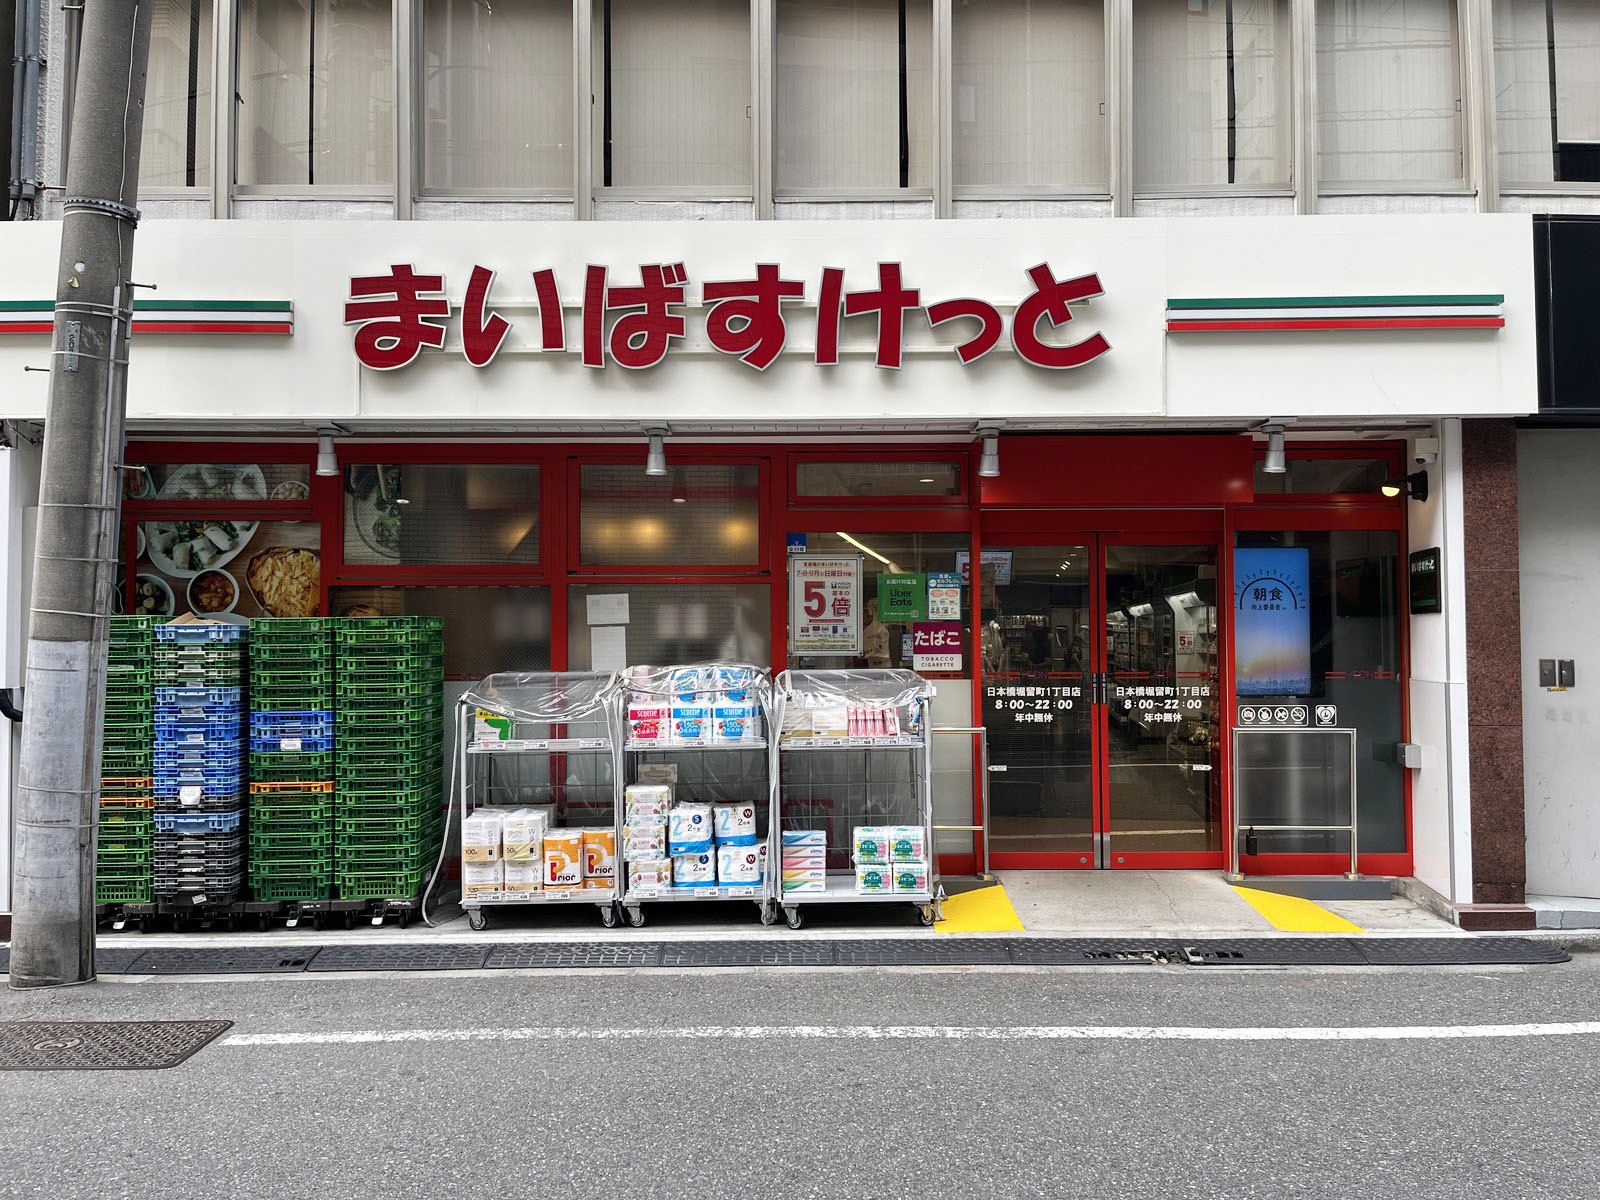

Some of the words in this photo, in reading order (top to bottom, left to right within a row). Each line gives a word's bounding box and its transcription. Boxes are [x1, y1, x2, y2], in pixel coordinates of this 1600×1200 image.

[344, 261, 1111, 372] まいばすけっと
[890, 589, 912, 597] Uber
[1253, 587, 1283, 601] 朝食
[890, 598, 913, 606] Eats
[914, 630, 960, 646] たばこ
[987, 686, 1081, 697] 日本橋堀留町1丁目店
[1116, 686, 1210, 697] 日本橋堀留町1丁目店
[1015, 713, 1053, 722] 年中無休
[1144, 713, 1182, 722] 年中無休
